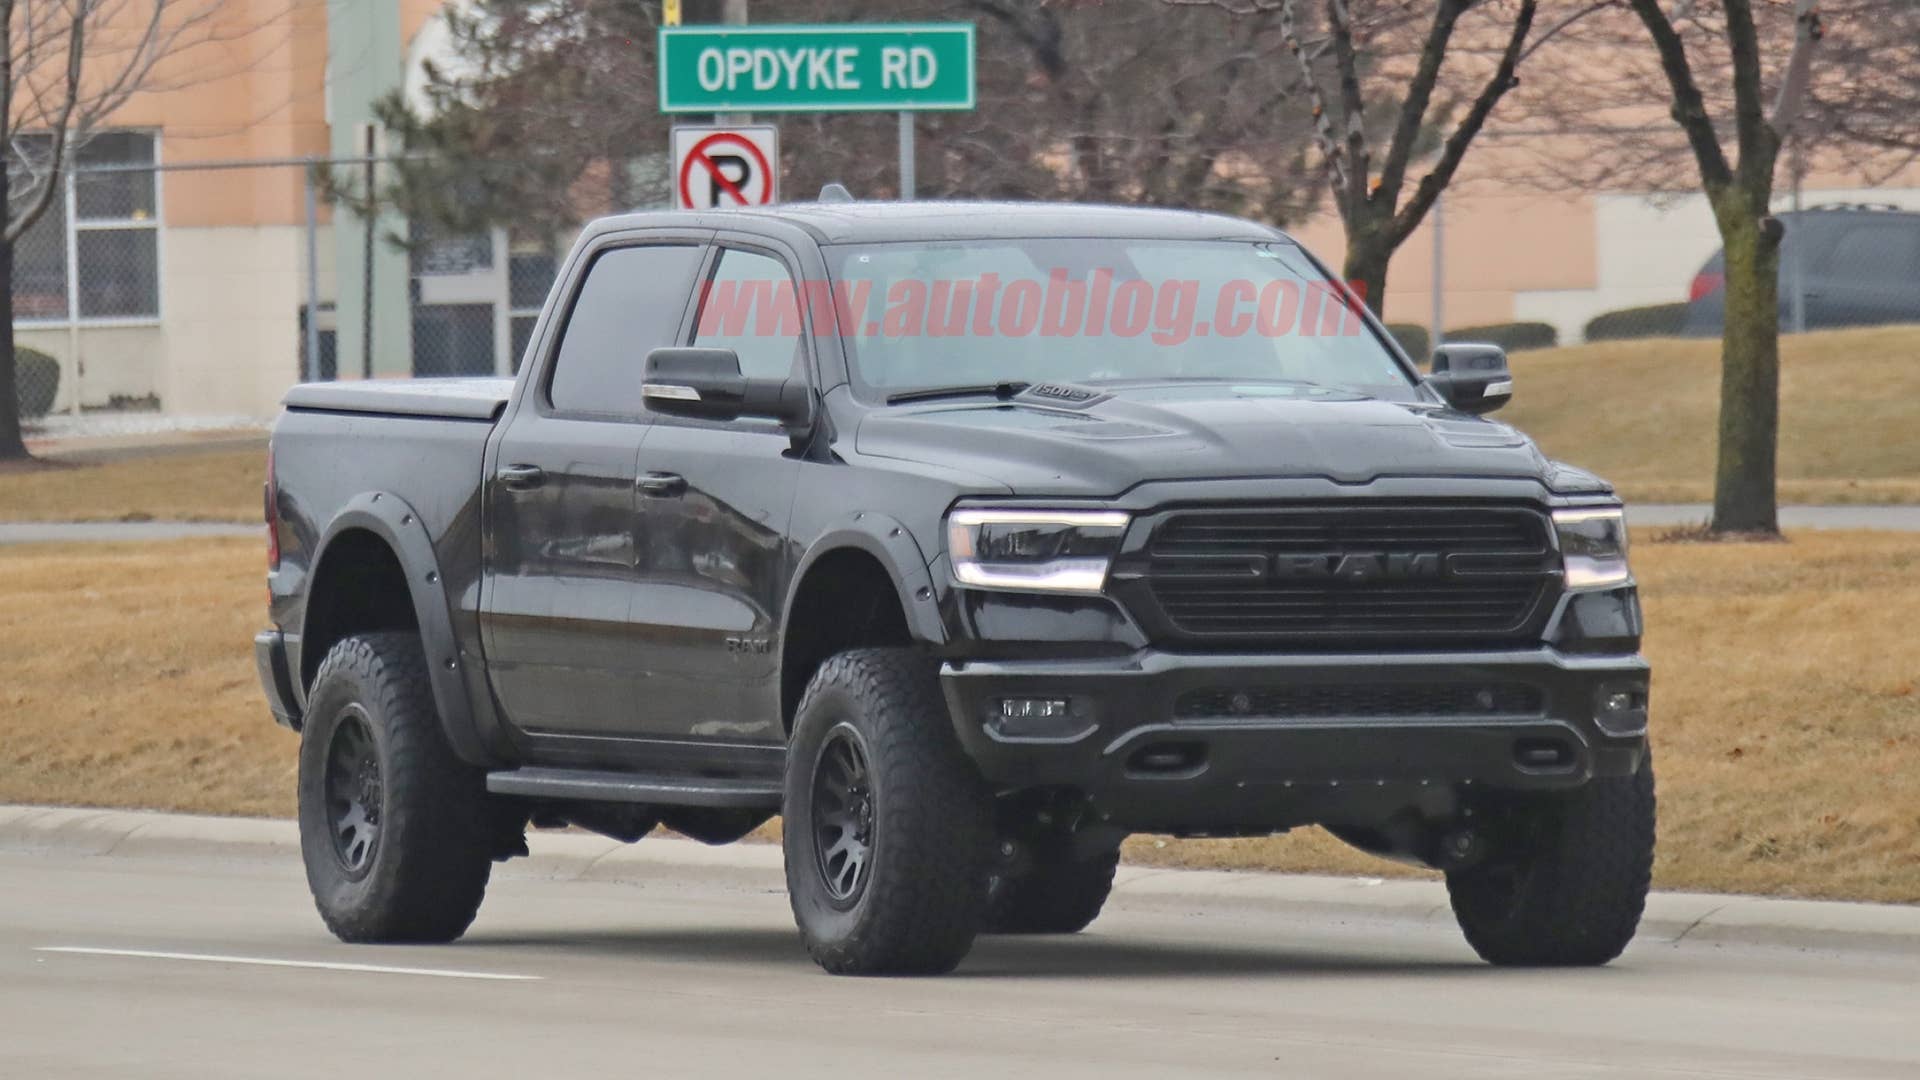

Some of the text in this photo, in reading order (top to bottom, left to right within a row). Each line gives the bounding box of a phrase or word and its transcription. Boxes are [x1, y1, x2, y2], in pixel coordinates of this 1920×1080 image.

[698, 47, 938, 91] OPDYKE RD
[709, 155, 750, 208] P
[1037, 384, 1073, 398] 1500
[1277, 552, 1439, 577] RAM
[725, 637, 770, 656] RAM
